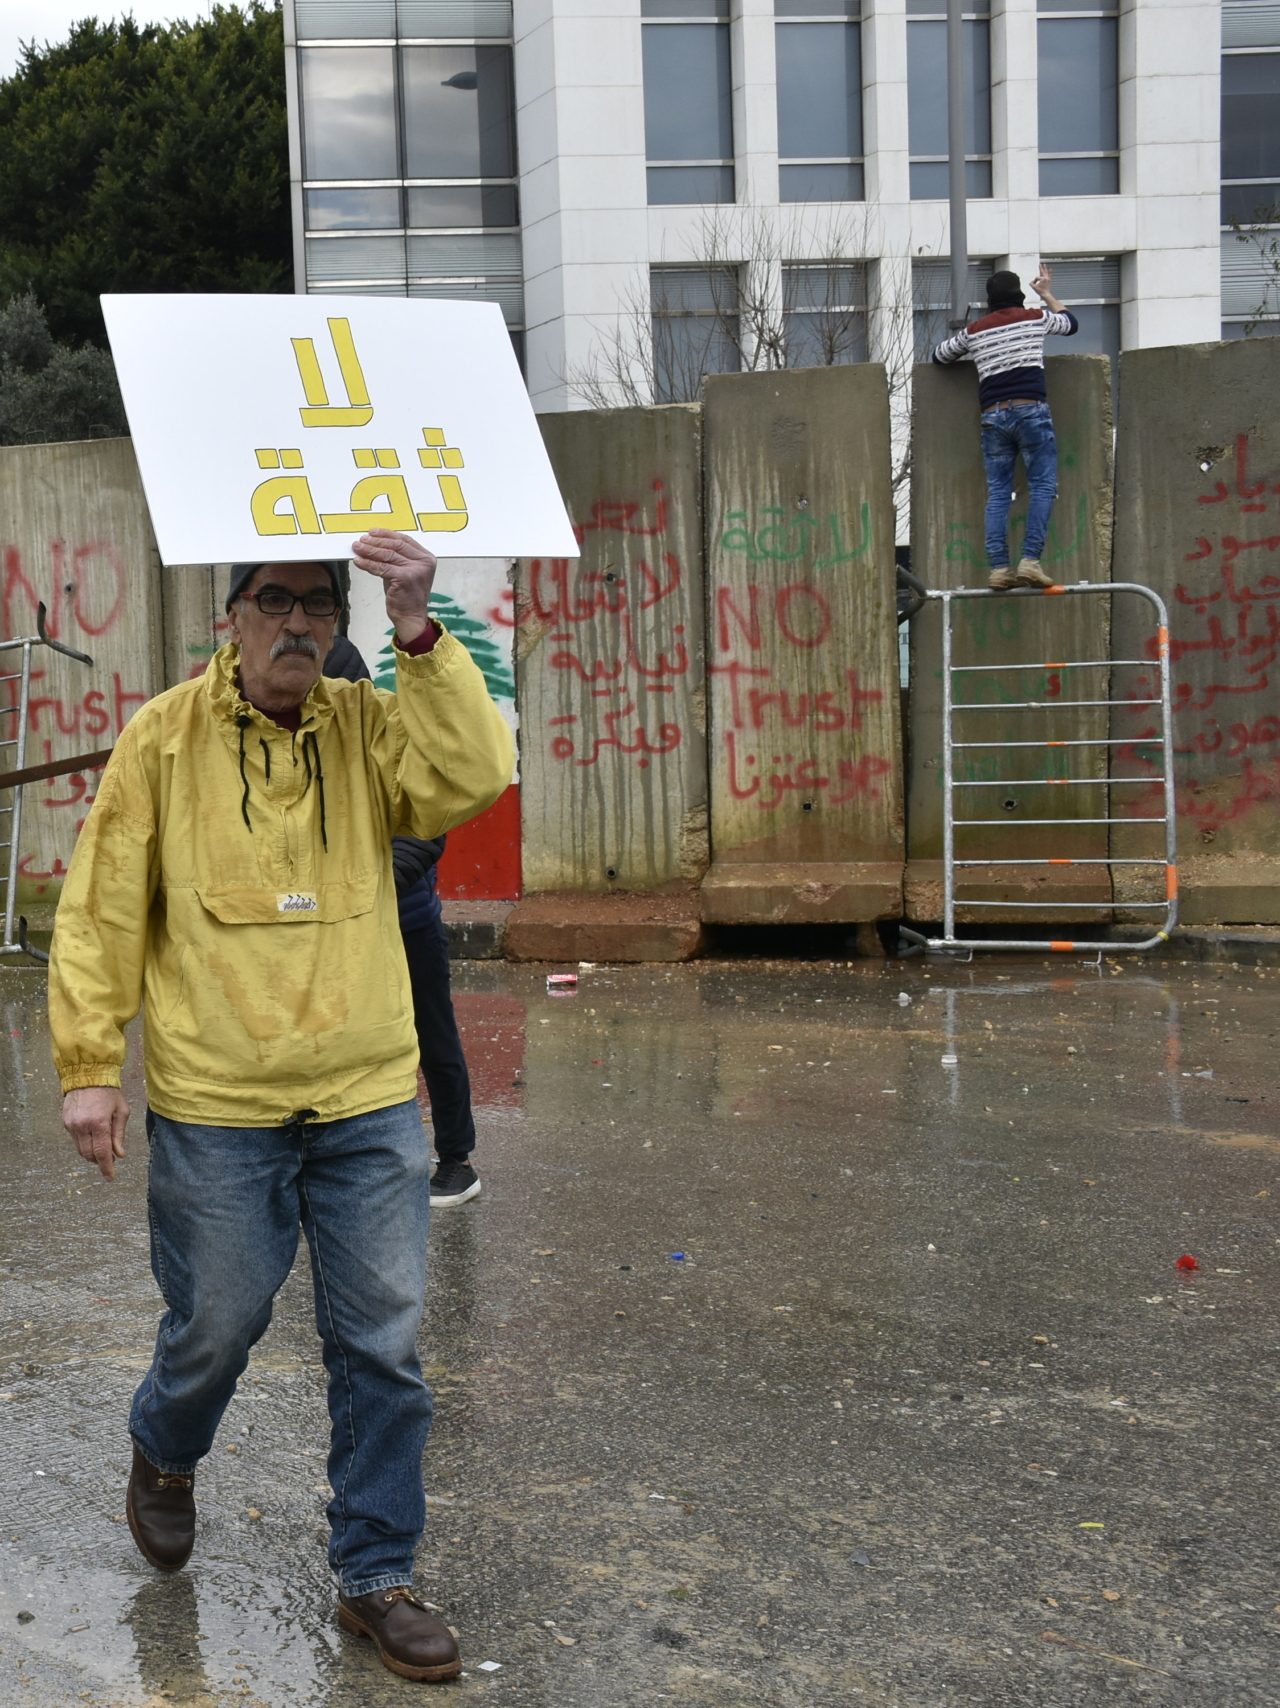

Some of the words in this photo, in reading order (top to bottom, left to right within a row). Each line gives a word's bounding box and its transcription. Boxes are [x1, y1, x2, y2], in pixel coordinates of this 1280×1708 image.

[290, 317, 373, 427] لا
[250, 427, 469, 536] ثقة
[4, 541, 125, 641] NO
[718, 582, 833, 653] NO
[710, 661, 885, 732] Trust
